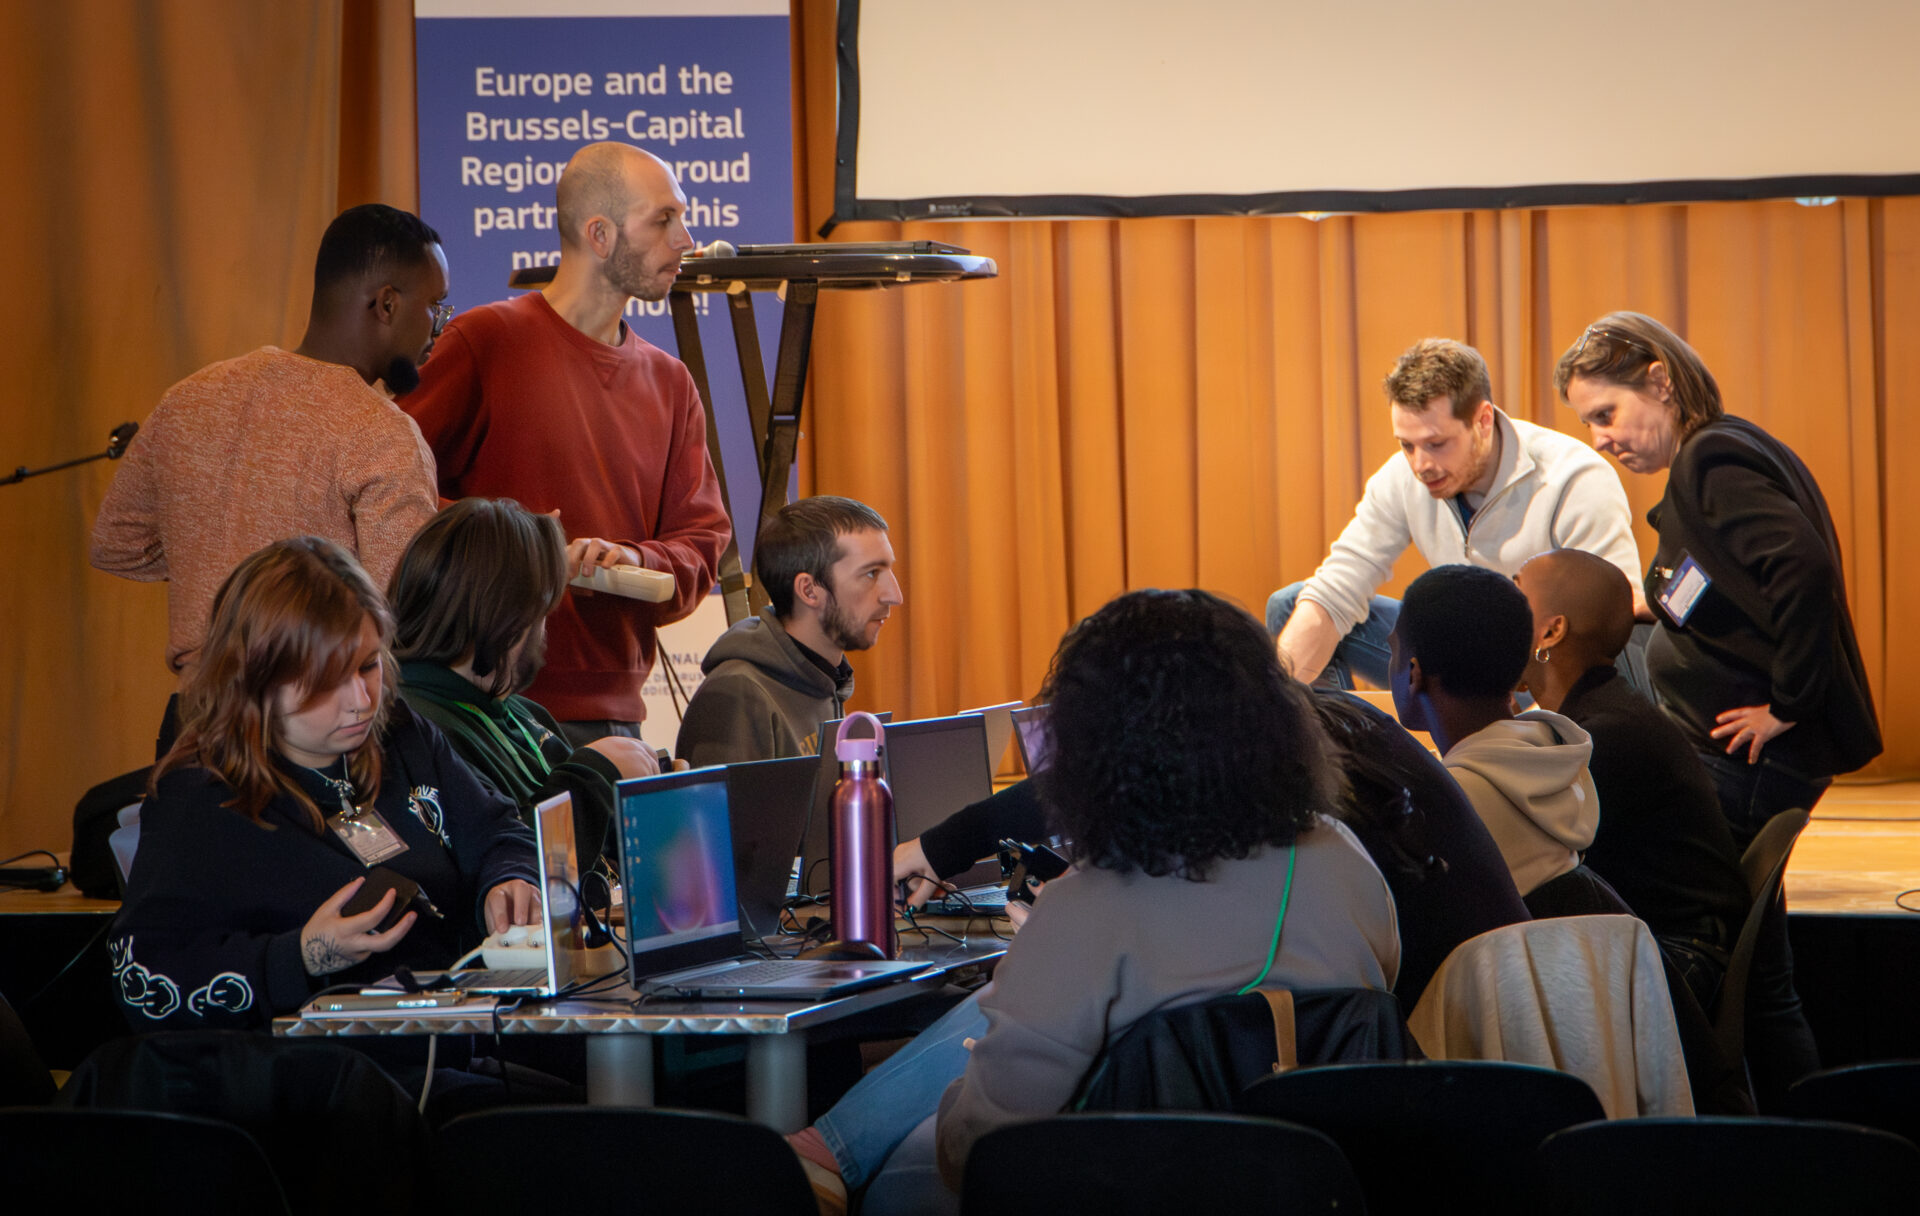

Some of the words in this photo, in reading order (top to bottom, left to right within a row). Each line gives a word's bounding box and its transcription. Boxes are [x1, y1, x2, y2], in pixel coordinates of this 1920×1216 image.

[475, 66, 592, 102] Europe
[605, 65, 667, 95] and
[679, 64, 734, 95] the
[466, 108, 745, 145] Brussels-Capital
[667, 152, 750, 184] roud
